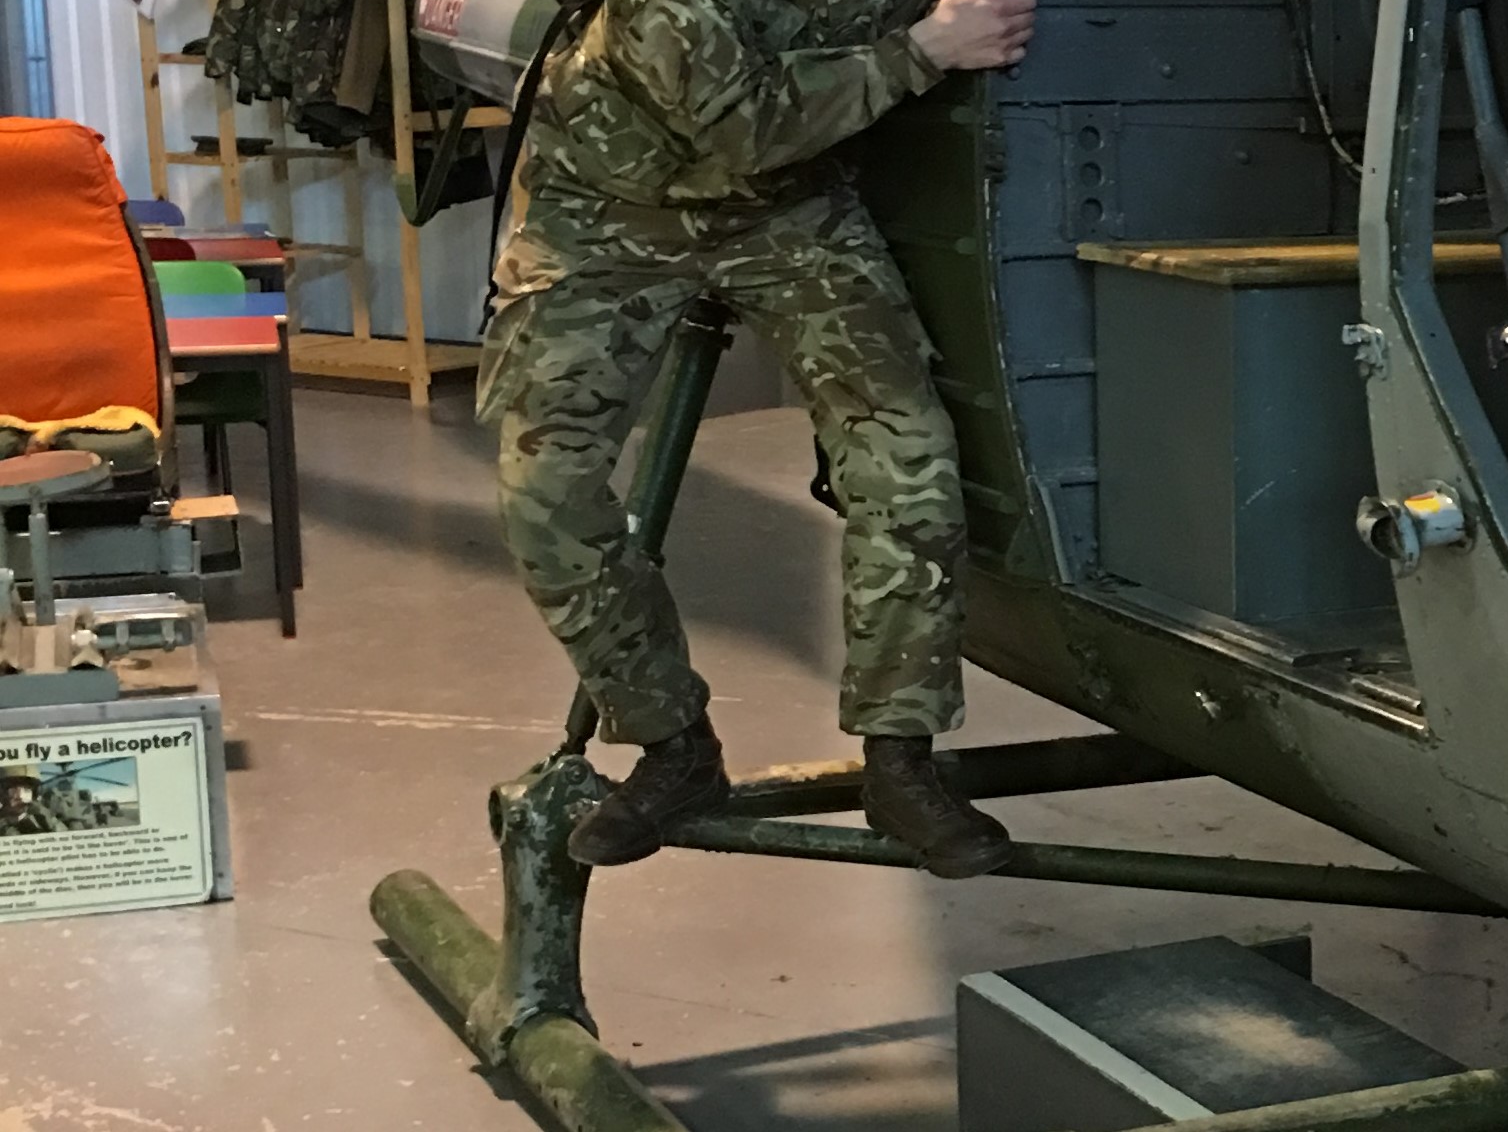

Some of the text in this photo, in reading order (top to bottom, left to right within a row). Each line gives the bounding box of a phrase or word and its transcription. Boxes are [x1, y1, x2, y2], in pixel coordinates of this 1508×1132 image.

[25, 742, 51, 761] fly
[58, 744, 70, 757] a
[76, 730, 192, 755] helicopter?
